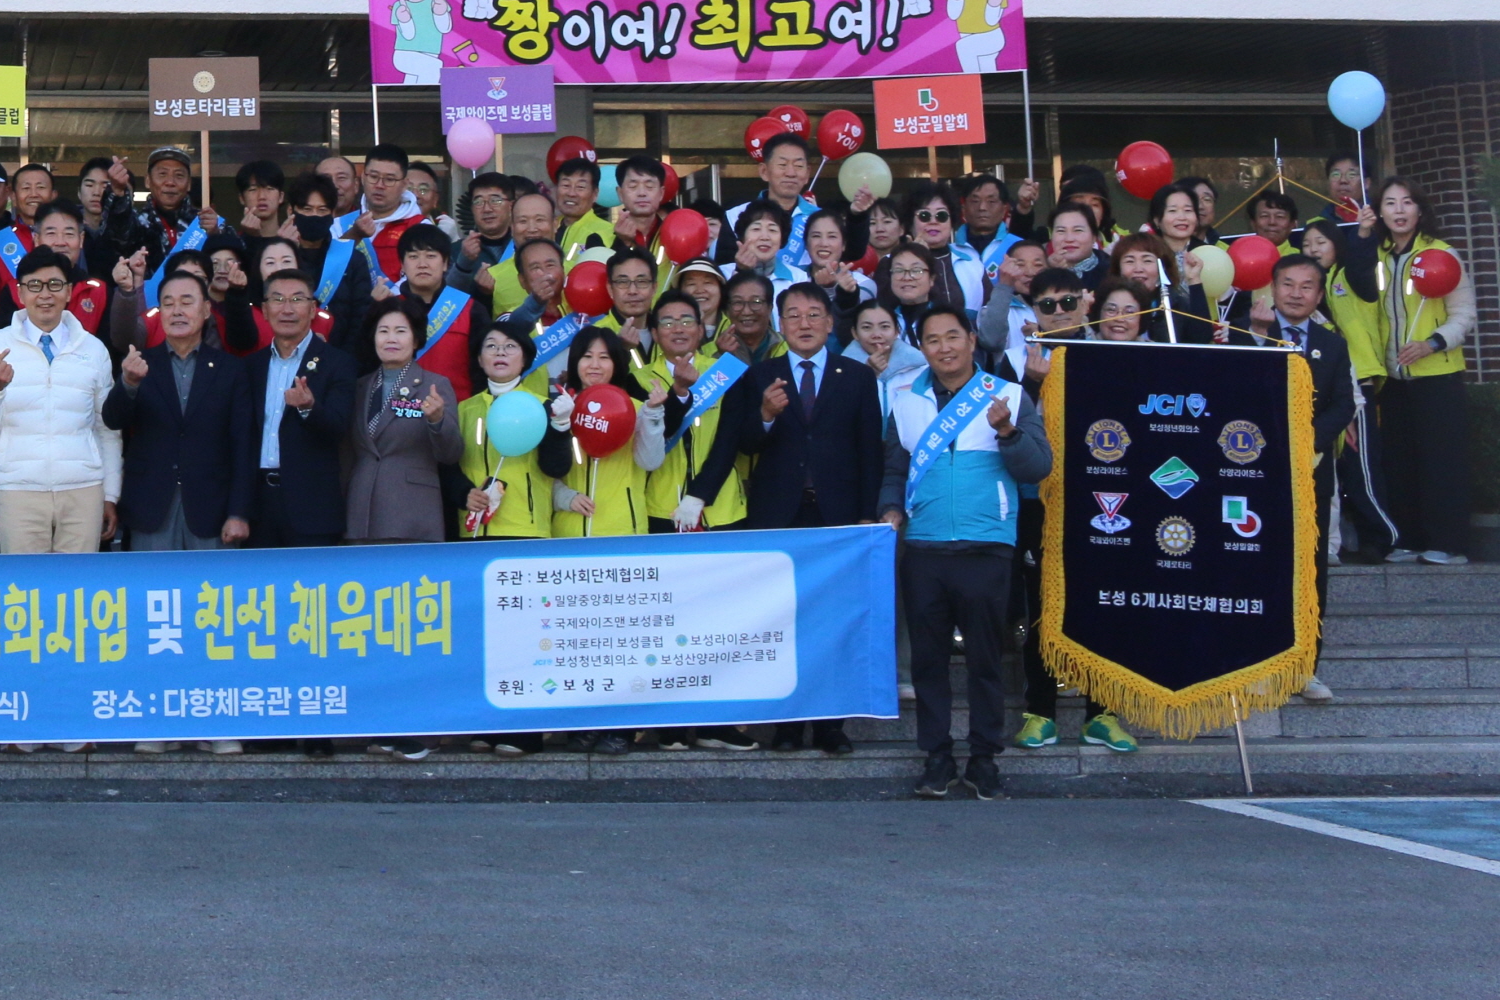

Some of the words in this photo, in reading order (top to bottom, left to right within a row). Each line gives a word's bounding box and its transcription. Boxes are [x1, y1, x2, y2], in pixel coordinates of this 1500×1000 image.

[153, 97, 256, 118] 보성로타리클럽
[510, 103, 552, 122] 보성클럽
[893, 112, 968, 135] 보성군밀알회
[836, 132, 858, 150] YOU
[1138, 393, 1184, 415] JCI
[574, 412, 609, 434] 사랑해
[1149, 423, 1201, 434] 보성청년회의소
[1102, 432, 1115, 448] L
[1236, 433, 1249, 449] L
[1085, 465, 1129, 476] 보성라이온스
[1218, 467, 1265, 478] 산양라이온스
[1156, 559, 1192, 570] 국제로타리
[536, 566, 659, 585] 보성사회단체협의회
[554, 591, 673, 608] 밀알중앙회보성군지회
[146, 588, 184, 655] 및
[628, 614, 675, 628] 보성클럽
[554, 637, 614, 651] 국제로타리
[616, 635, 664, 650] 보성클럽
[690, 630, 784, 647] 보성라이온스클럽
[554, 654, 639, 669] 보성청년회의소
[660, 648, 777, 667] 보성산양라이온스클럽
[651, 674, 712, 690] 보성군의회
[164, 687, 292, 718] 다향체육관
[298, 685, 348, 716] 일원
